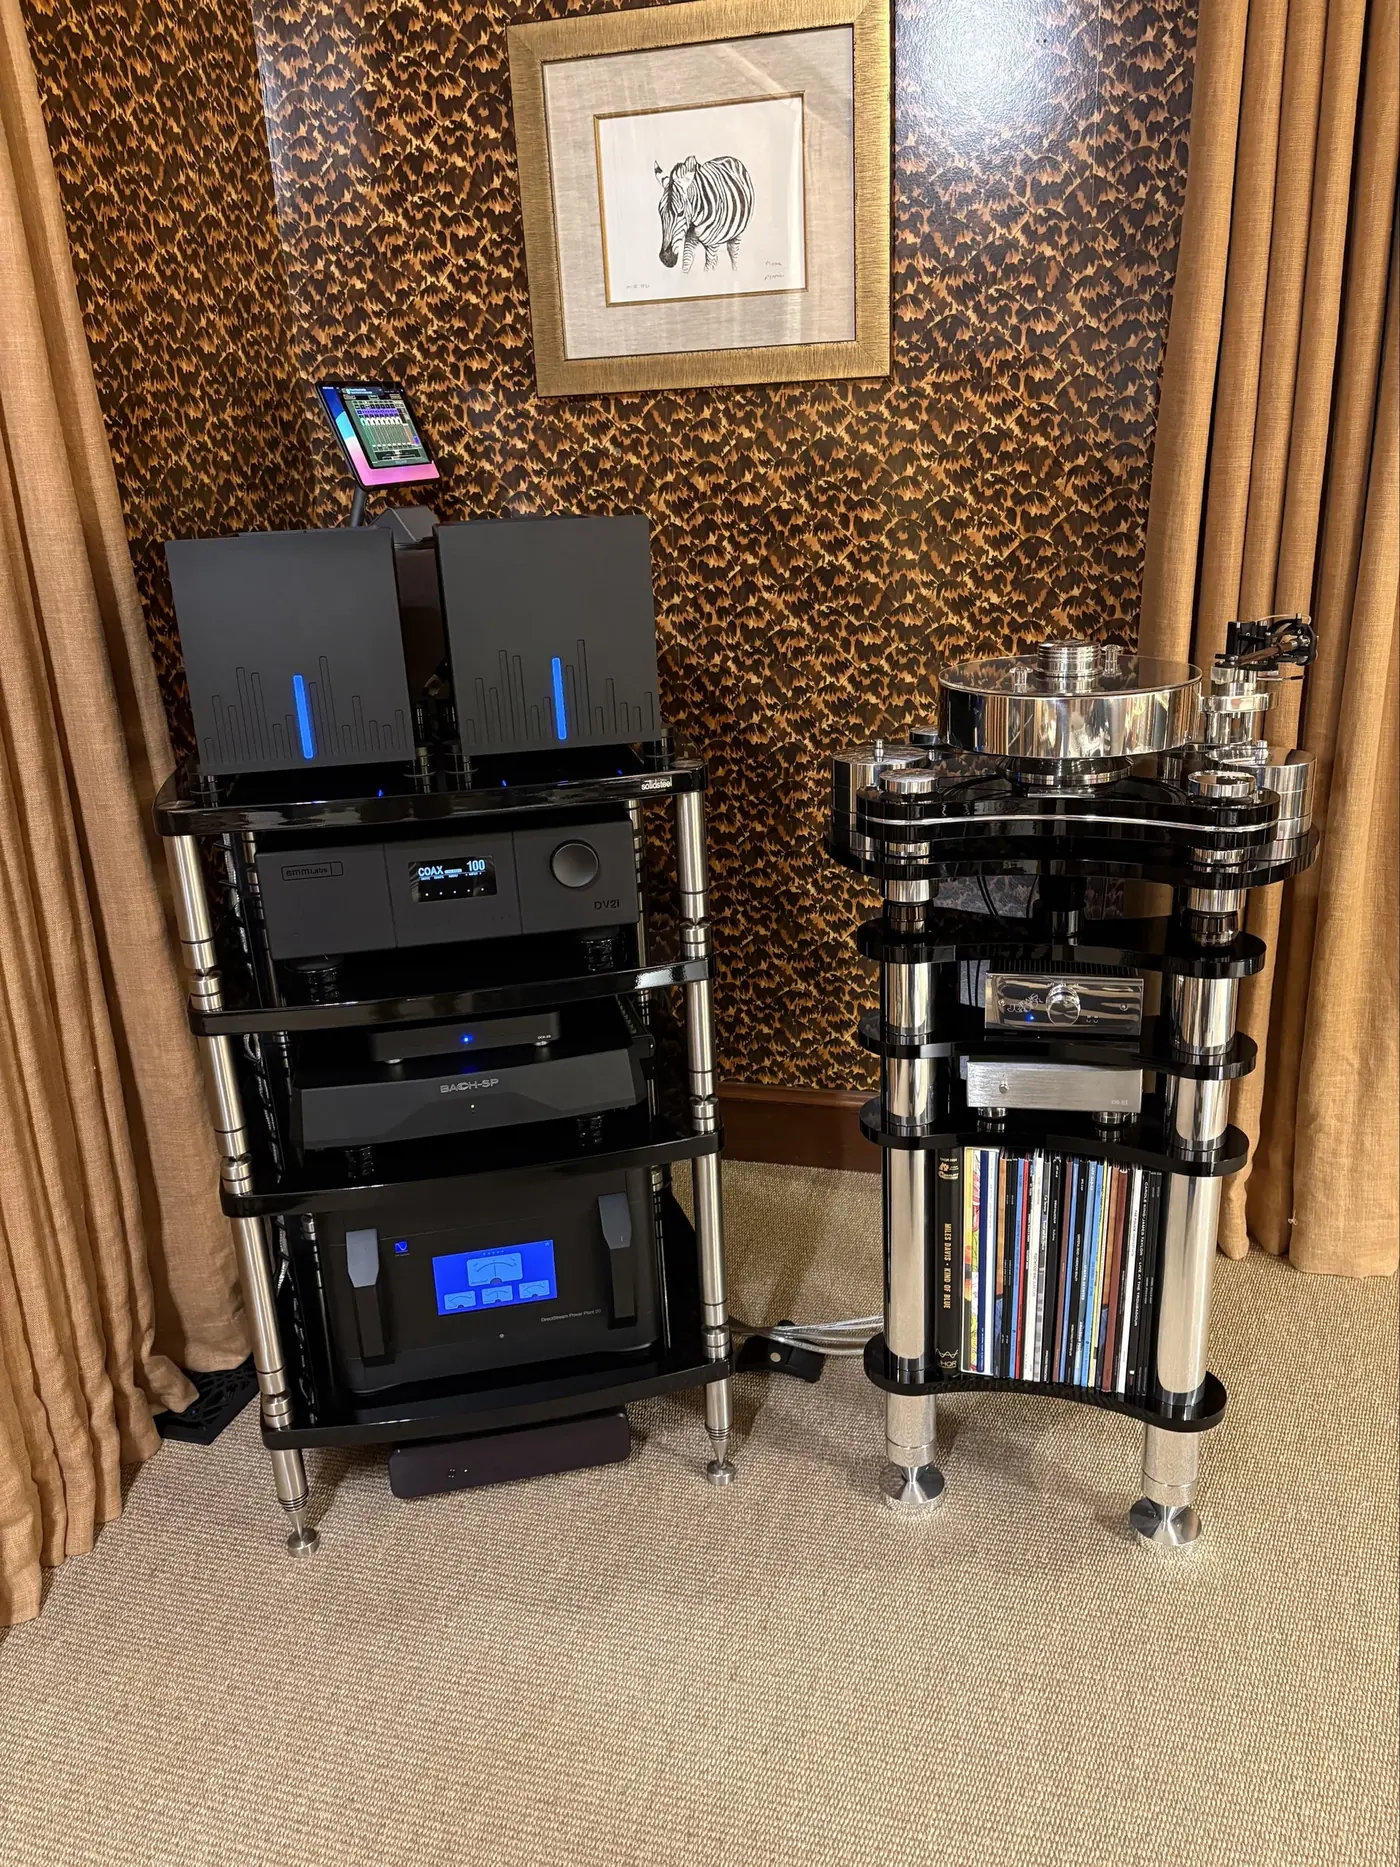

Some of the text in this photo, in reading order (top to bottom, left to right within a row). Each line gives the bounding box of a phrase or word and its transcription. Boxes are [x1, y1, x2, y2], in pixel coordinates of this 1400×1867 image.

[641, 776, 672, 790] solidsteel
[418, 859, 486, 877] COAX 100
[943, 1223, 952, 1309] MILES DAVIS KIND OF BLUE
